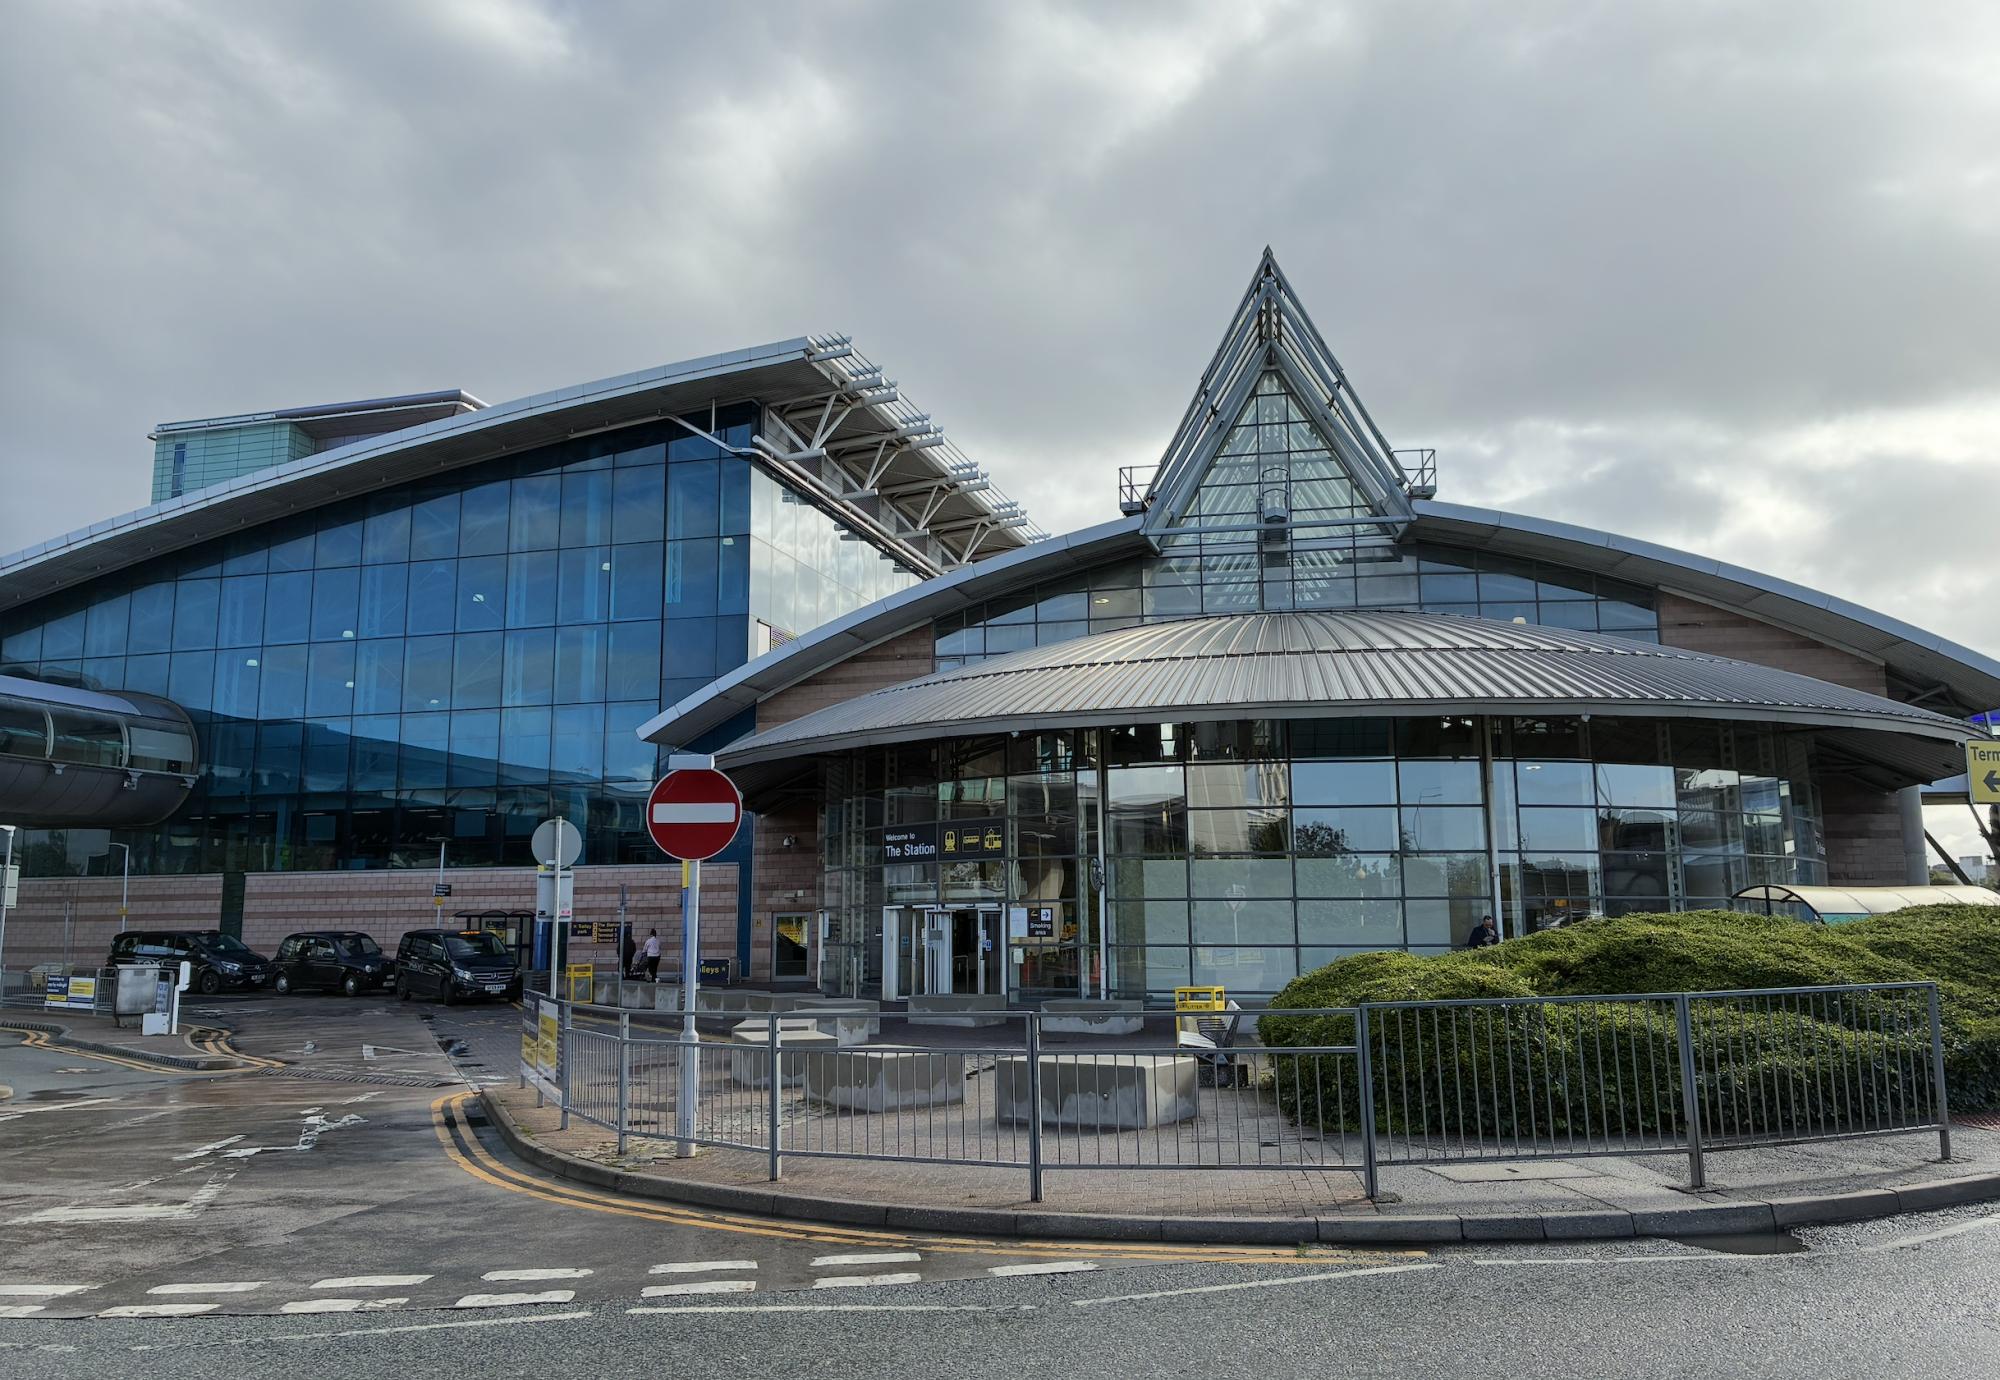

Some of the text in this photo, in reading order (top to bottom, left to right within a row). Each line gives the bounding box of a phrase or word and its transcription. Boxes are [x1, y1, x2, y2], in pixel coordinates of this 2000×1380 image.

[885, 832, 916, 842] Welcome to
[885, 842, 936, 857] The Station
[1030, 922, 1052, 930] Smoking
[700, 965, 720, 975] lleys
